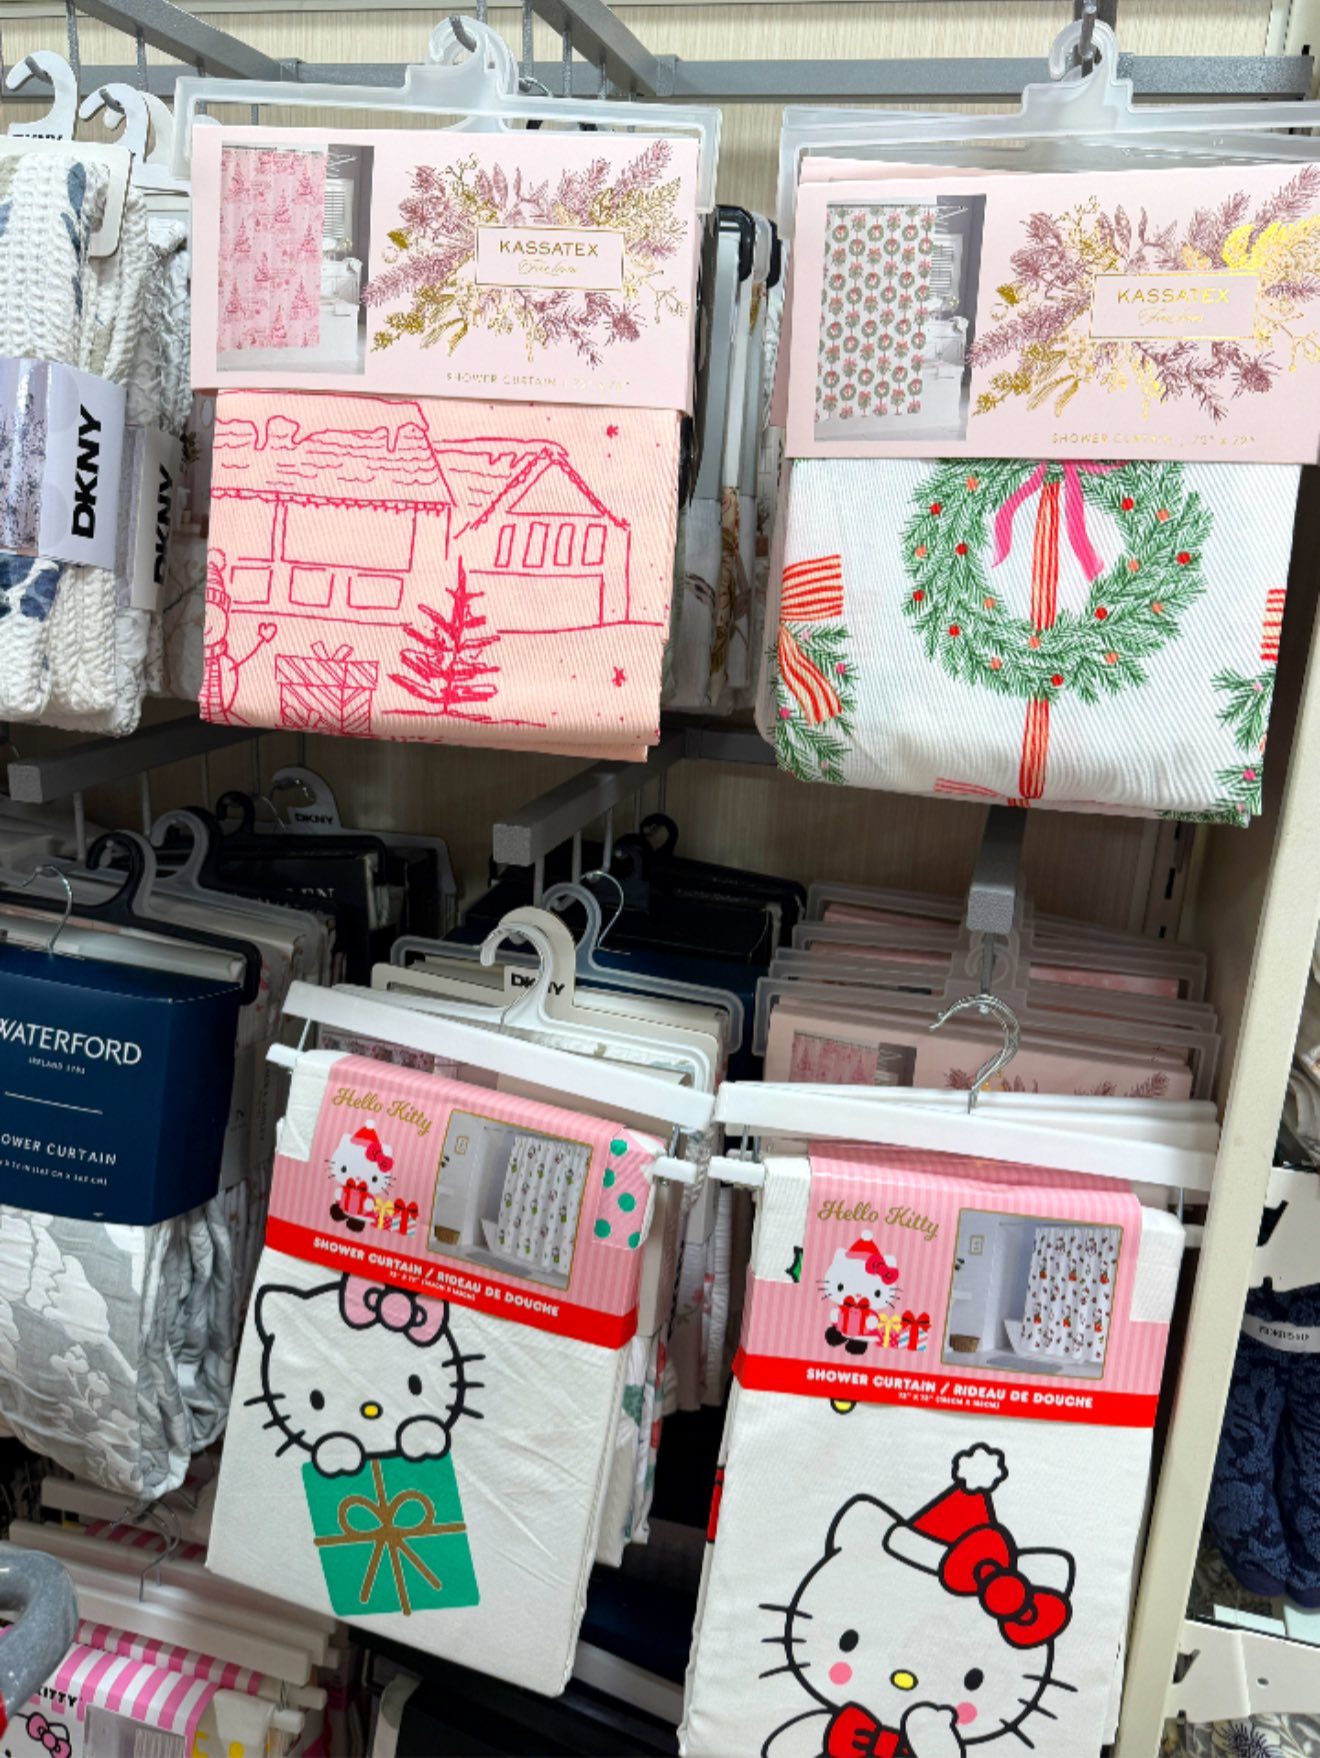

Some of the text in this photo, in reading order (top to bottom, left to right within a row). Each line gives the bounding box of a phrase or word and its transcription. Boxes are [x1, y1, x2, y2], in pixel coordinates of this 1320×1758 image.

[499, 240, 599, 257] KASSATEX
[1117, 287, 1230, 305] KASSATEX
[447, 372, 498, 384] SHOWER
[1051, 432, 1109, 444] SHOWER
[72, 404, 101, 539] DKNY
[154, 463, 172, 585] DKNY
[295, 813, 333, 825] DKNY
[511, 972, 565, 996] DKY
[0, 1018, 142, 1066] WATERFORD
[332, 1087, 433, 1137] Hello Kitty
[1, 1133, 117, 1166] OWER CURTAIN
[817, 1199, 939, 1241] Hello Kitty
[313, 1236, 365, 1261] SHOWER
[368, 1252, 422, 1276] CURTAIN
[437, 1271, 482, 1294] RIDEAU
[485, 1285, 502, 1301] DE
[504, 1291, 560, 1318] DOUCHE
[805, 1368, 869, 1386] SHOWER
[872, 1375, 937, 1393] CURTAIN
[953, 1383, 1007, 1401] RIDEAU
[1009, 1390, 1030, 1403] DE
[1032, 1393, 1094, 1410] DOUCHE
